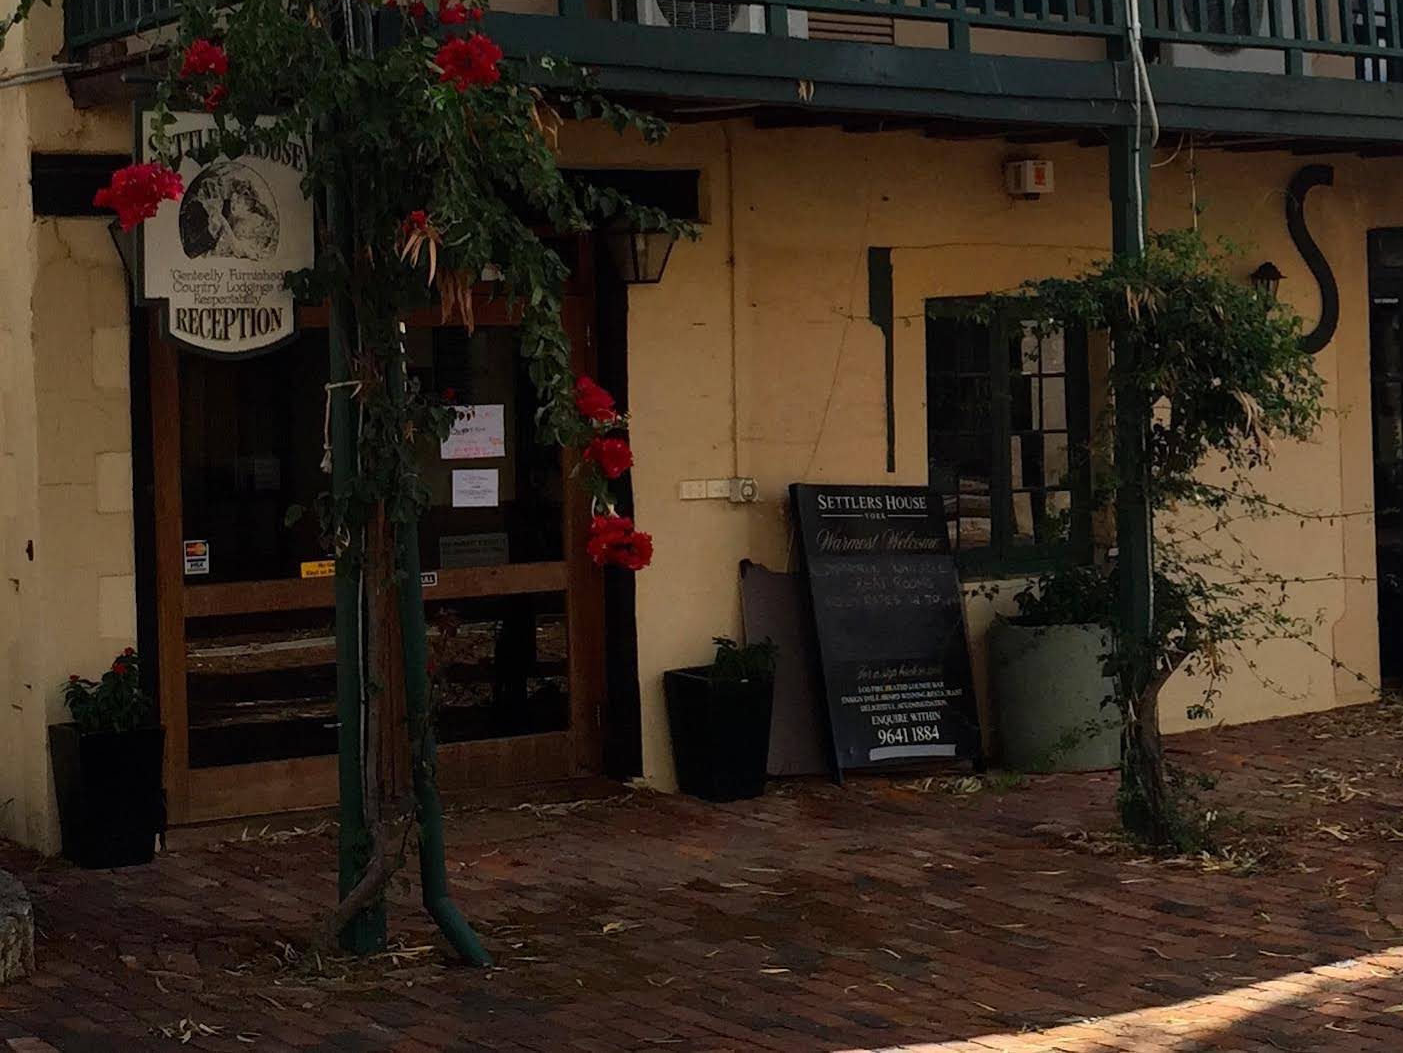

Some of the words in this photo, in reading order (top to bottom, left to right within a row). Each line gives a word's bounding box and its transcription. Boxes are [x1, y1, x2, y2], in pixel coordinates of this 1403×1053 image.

[173, 281, 221, 293] Country
[176, 307, 284, 340] RECEPTION
[817, 494, 883, 509] SETTLERS
[885, 495, 928, 510] HOUSE
[816, 528, 880, 551] Warmest
[871, 713, 909, 726] ENQUIRE
[909, 711, 942, 722] WITHIN
[878, 727, 909, 745] 9641
[911, 725, 940, 742] 1884
